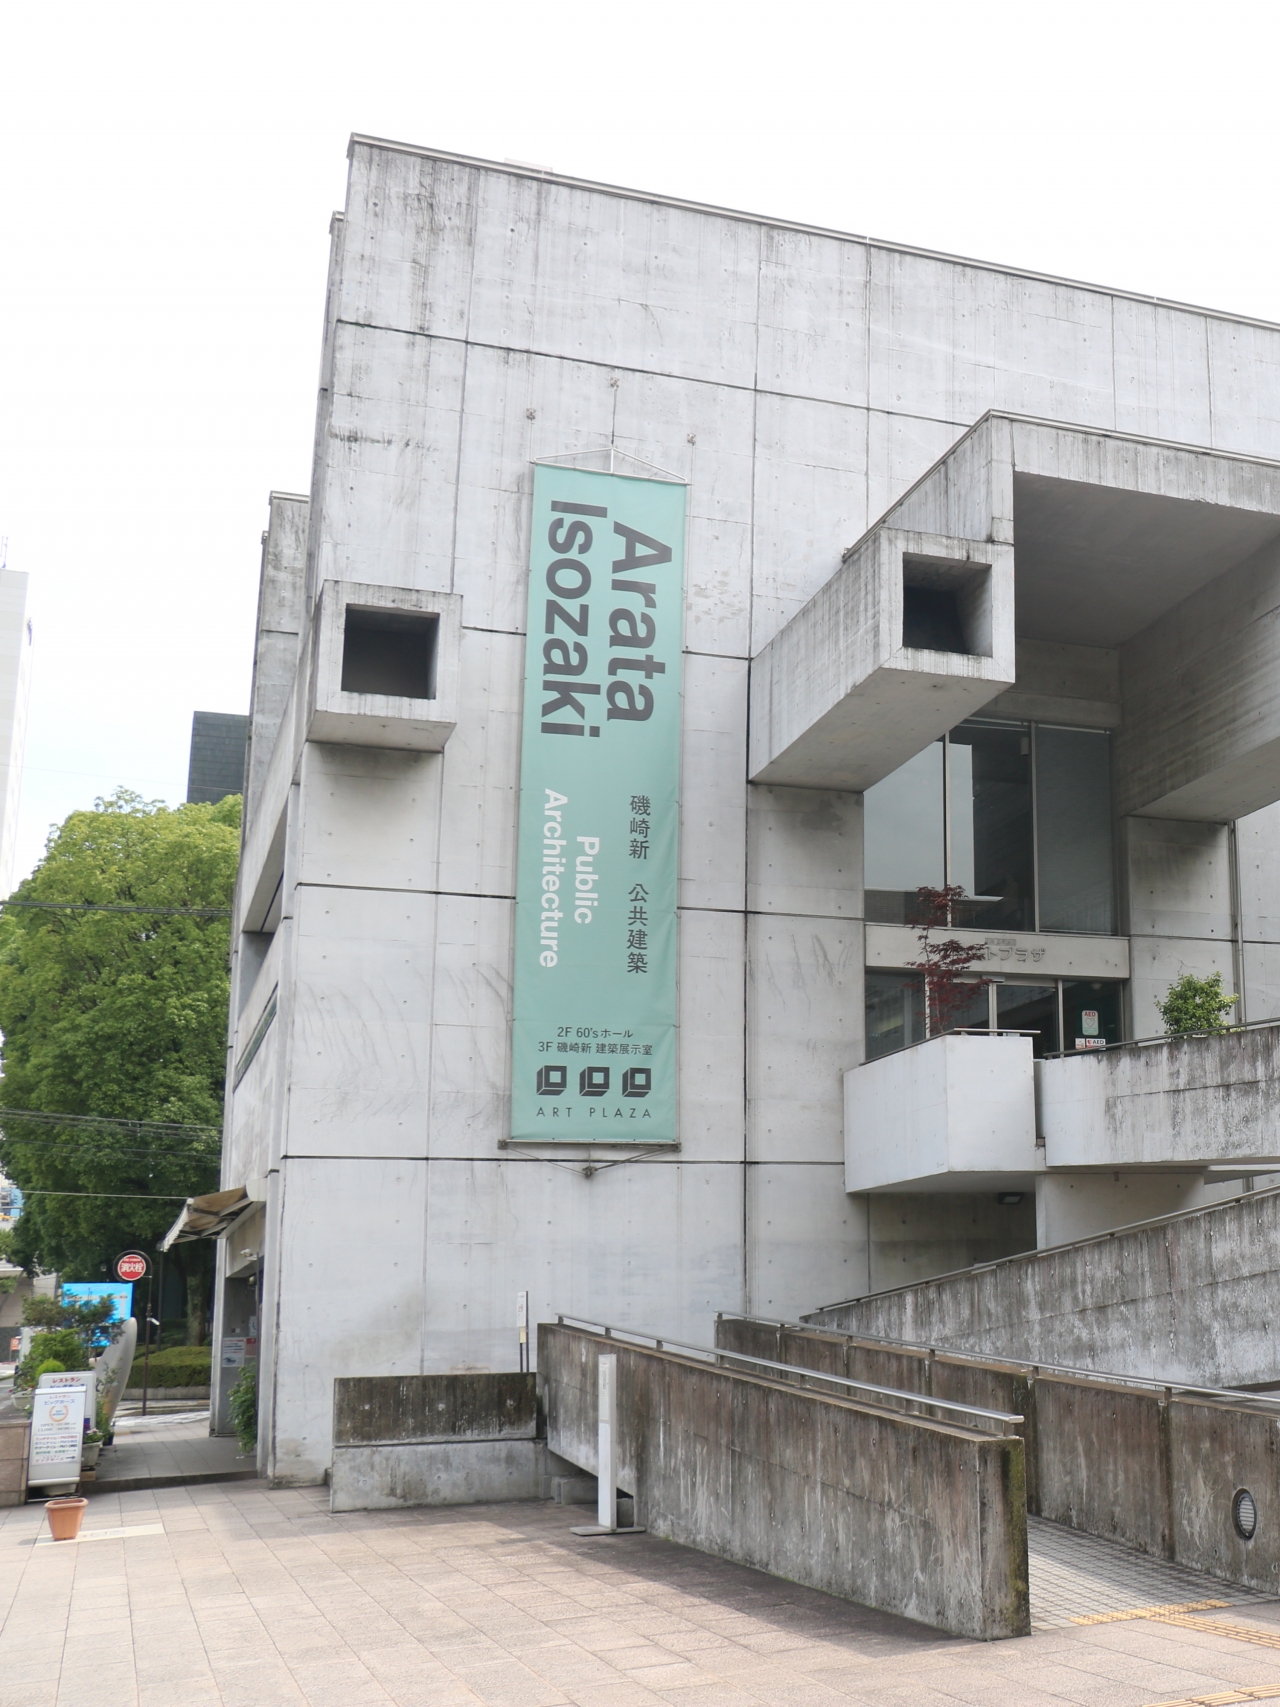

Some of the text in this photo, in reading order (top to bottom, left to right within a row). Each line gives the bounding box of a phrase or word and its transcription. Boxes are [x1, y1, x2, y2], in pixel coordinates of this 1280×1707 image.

[541, 500, 608, 738] Isozaki
[606, 521, 673, 722] Arata
[539, 788, 568, 967] Architecture
[574, 836, 600, 924] Public
[626, 795, 651, 974] 磯崎新 公共建築
[970, 946, 1046, 962] トプラザ
[538, 1041, 553, 1052] 3F
[595, 1043, 653, 1056] 建築展示室
[557, 1026, 572, 1038] 2F
[536, 1107, 651, 1119] ART PLAZA
[121, 1262, 144, 1273] 消火栓
